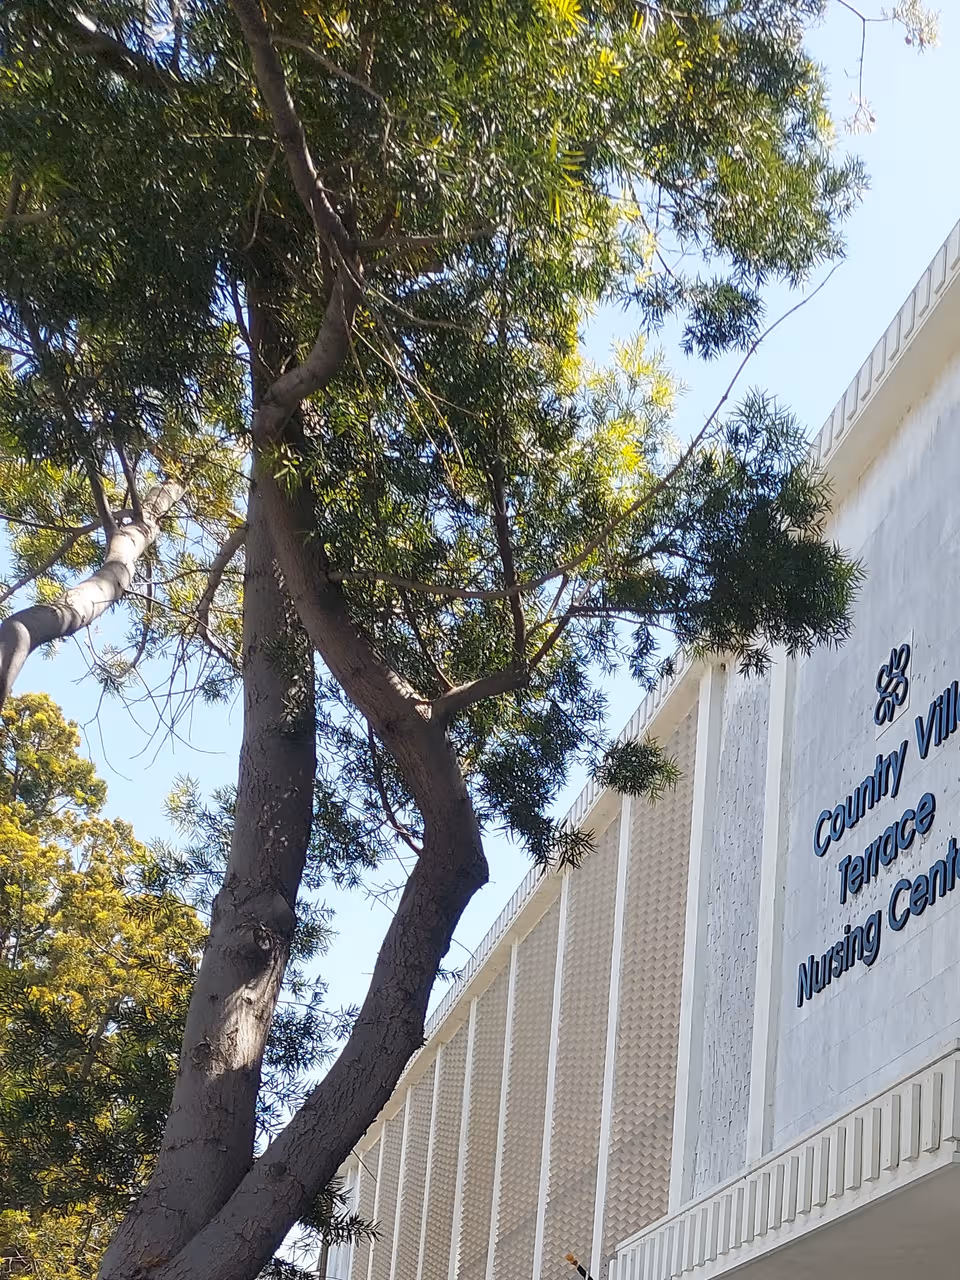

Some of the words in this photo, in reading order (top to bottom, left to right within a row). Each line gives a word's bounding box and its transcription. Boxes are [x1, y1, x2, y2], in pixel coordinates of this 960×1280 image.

[813, 740, 909, 857] Country
[838, 792, 936, 904] Terrace
[797, 909, 882, 1007] Nursing
